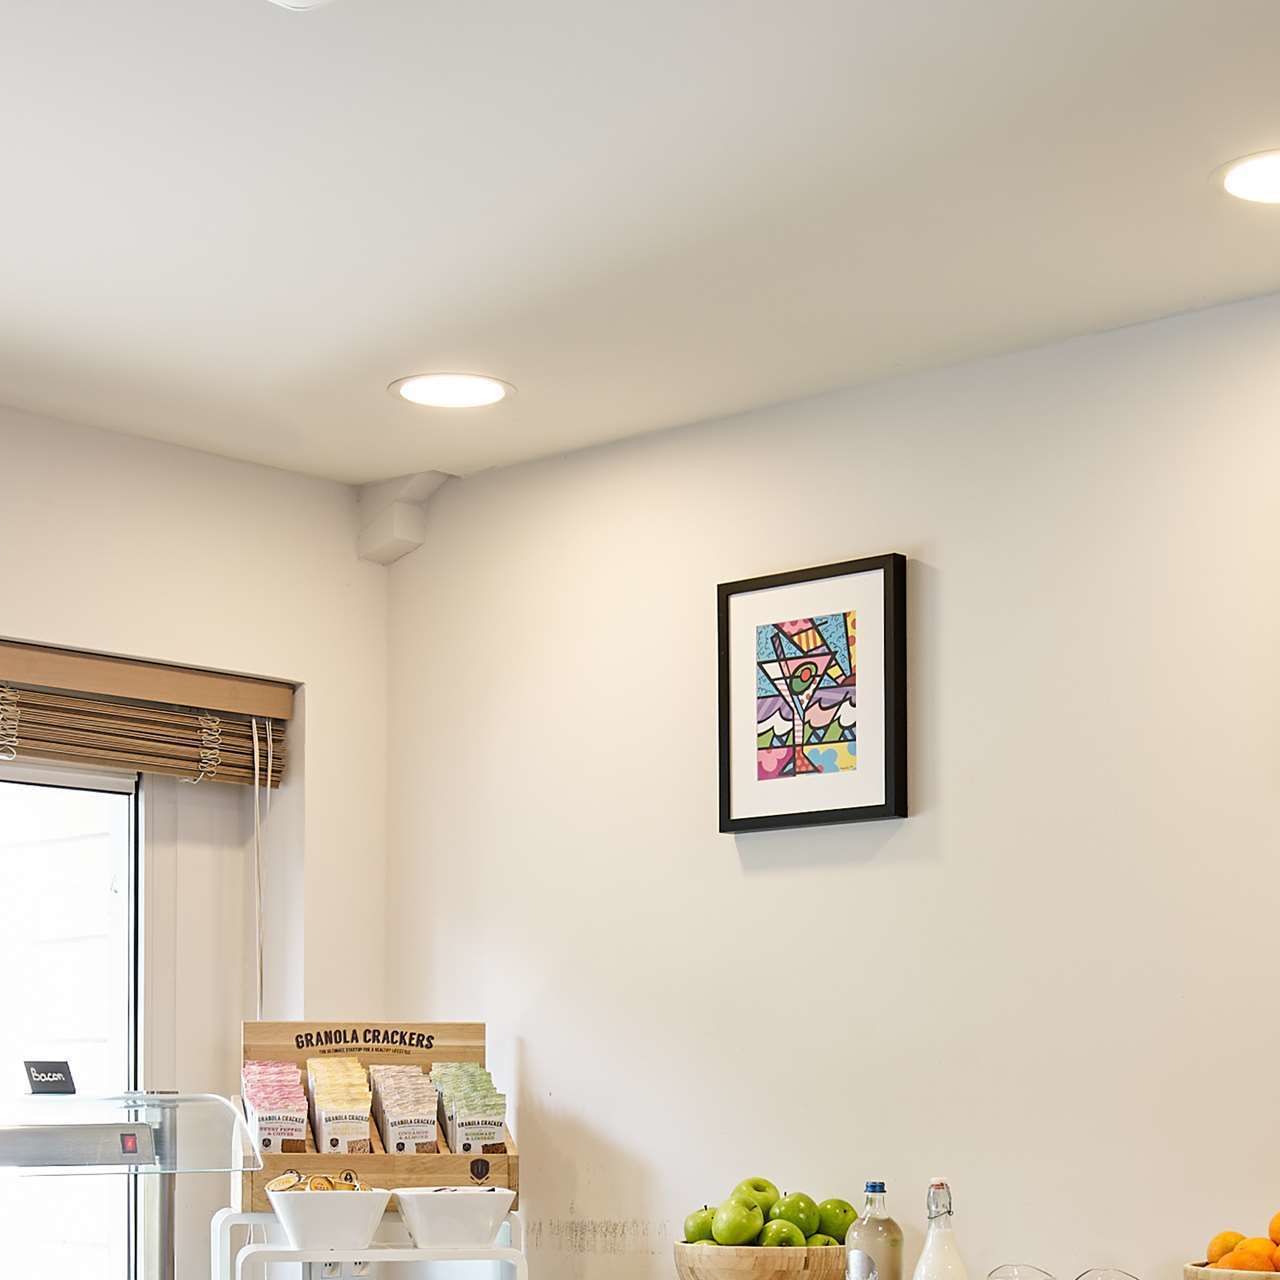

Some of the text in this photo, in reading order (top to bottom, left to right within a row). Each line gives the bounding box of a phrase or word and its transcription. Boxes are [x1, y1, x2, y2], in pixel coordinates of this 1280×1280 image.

[294, 1029, 435, 1049] GRANOLA CRACKERS
[30, 1066, 65, 1082] Bacon
